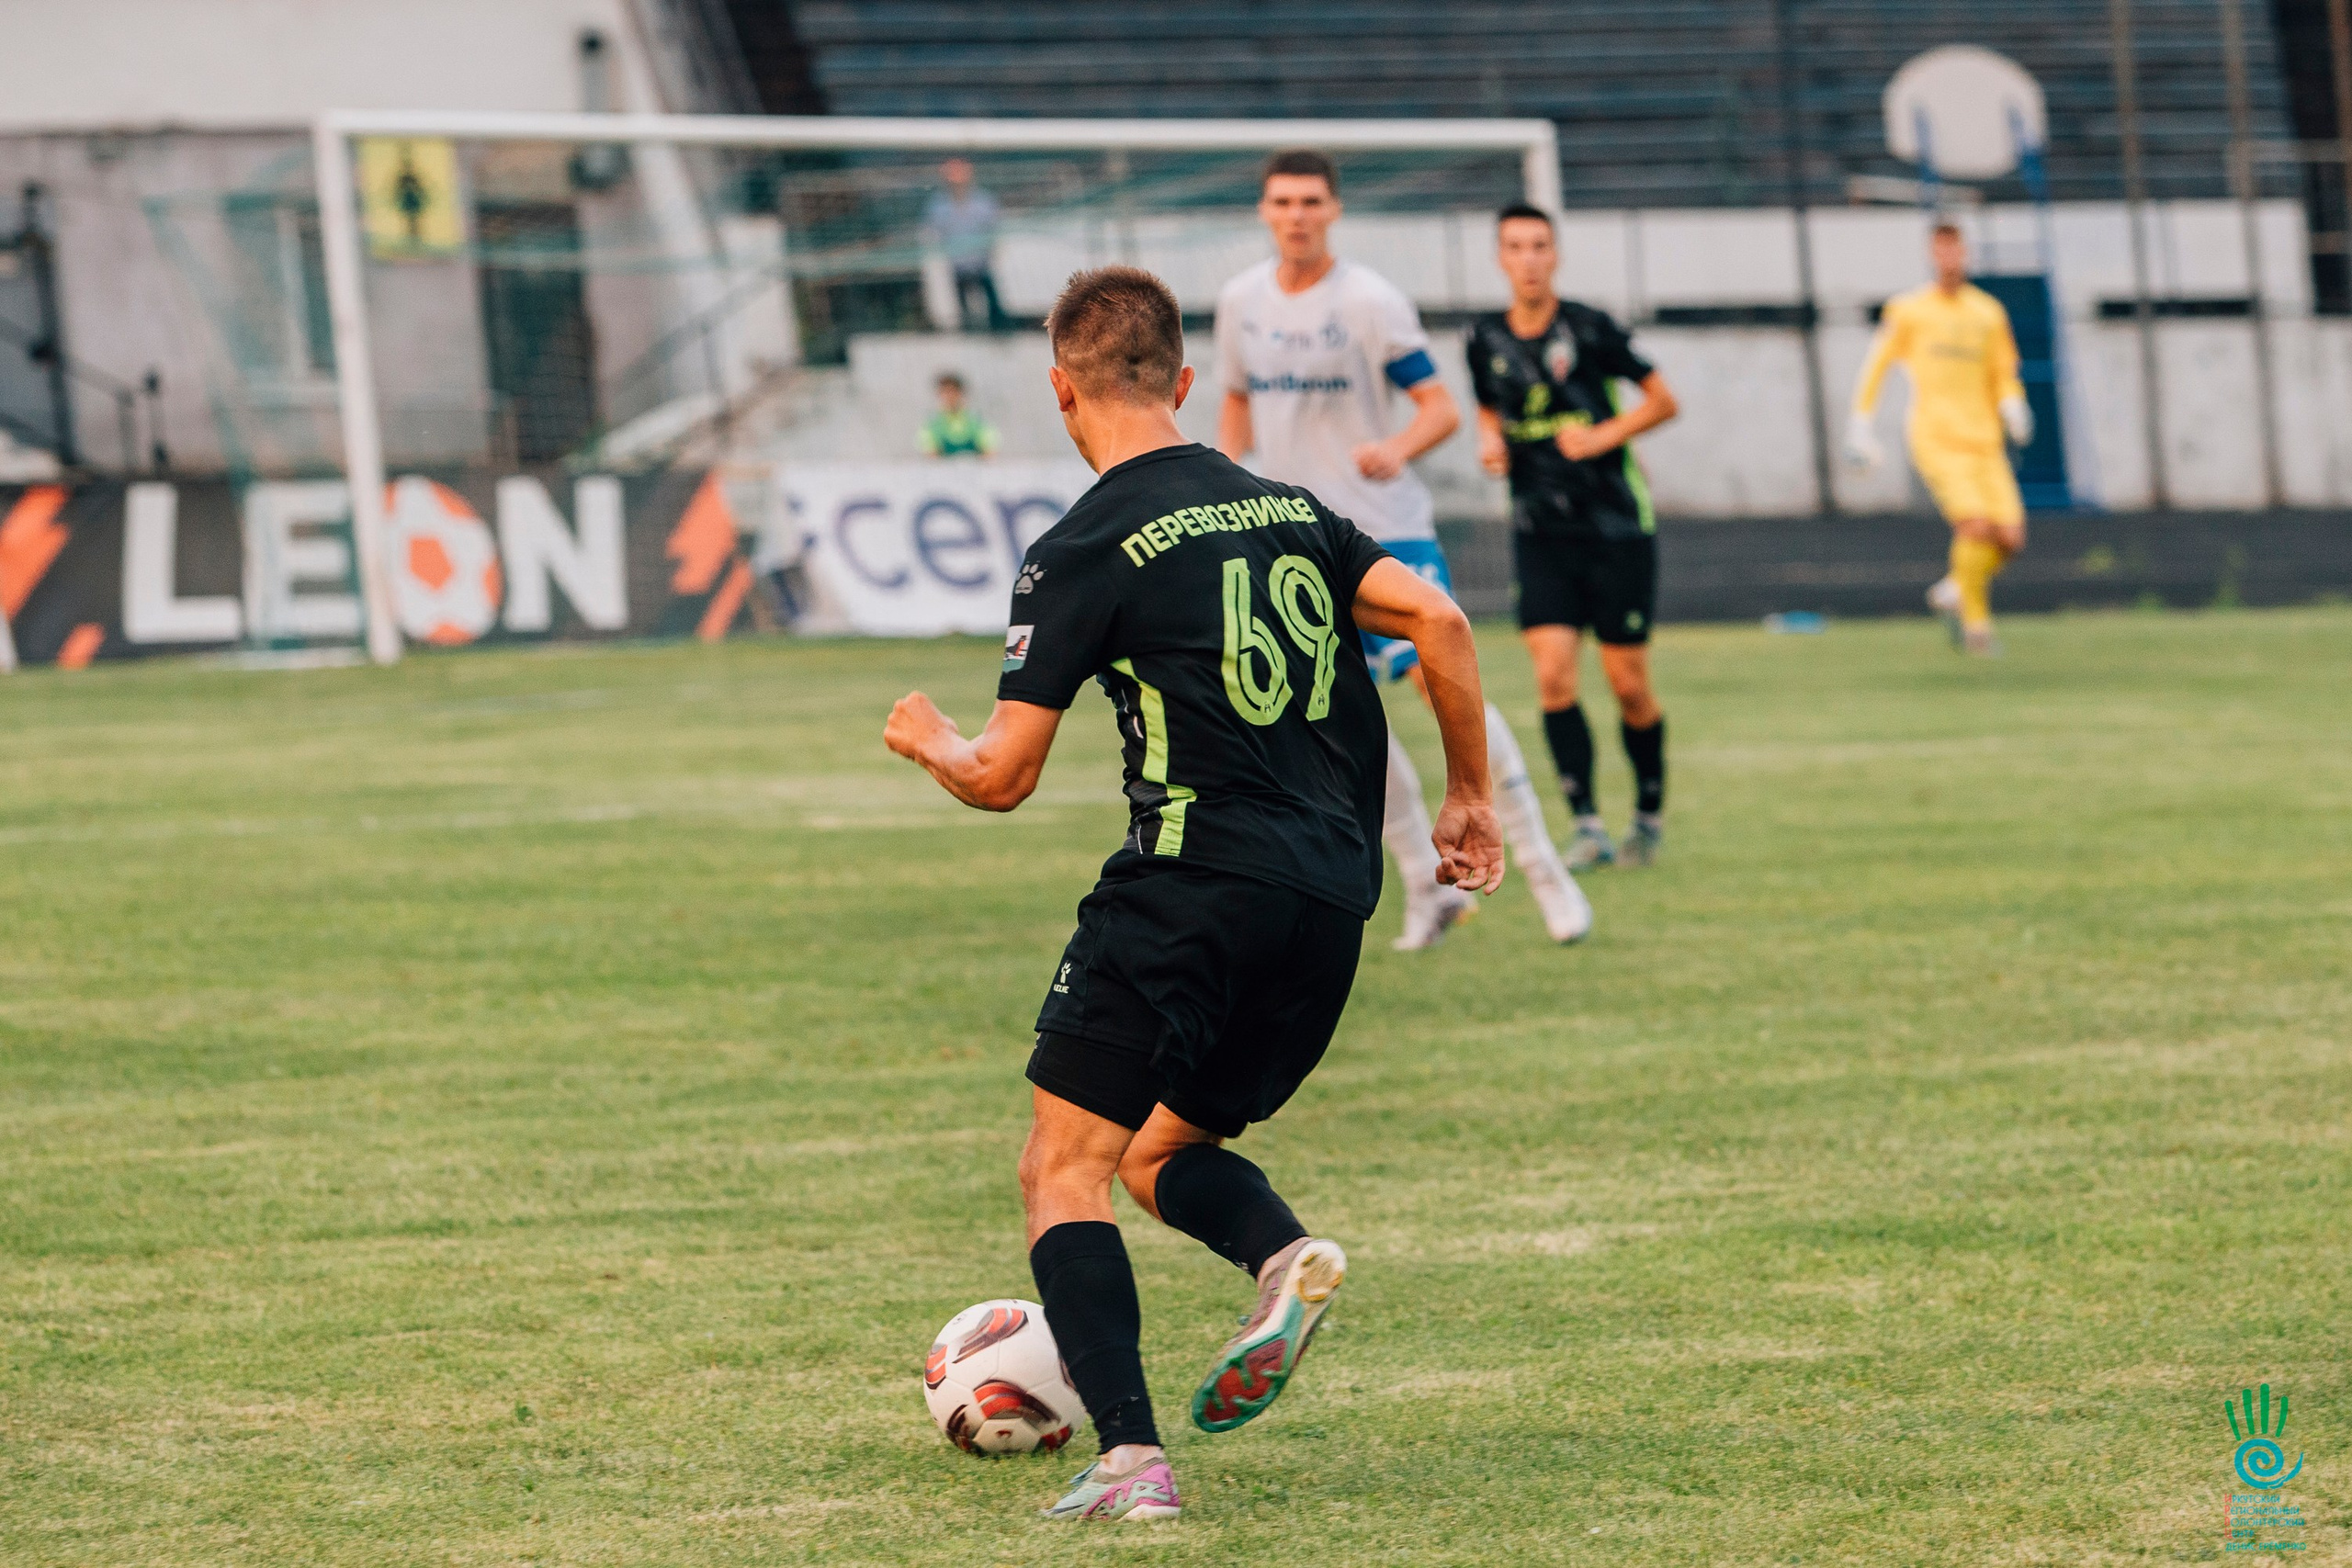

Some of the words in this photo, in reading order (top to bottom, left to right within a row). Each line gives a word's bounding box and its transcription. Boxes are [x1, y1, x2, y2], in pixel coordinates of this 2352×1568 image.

[121, 476, 628, 646] LEON
[1120, 494, 1318, 568] ПЕРЕВОЗНИКОВ
[1220, 554, 1341, 727] 69
